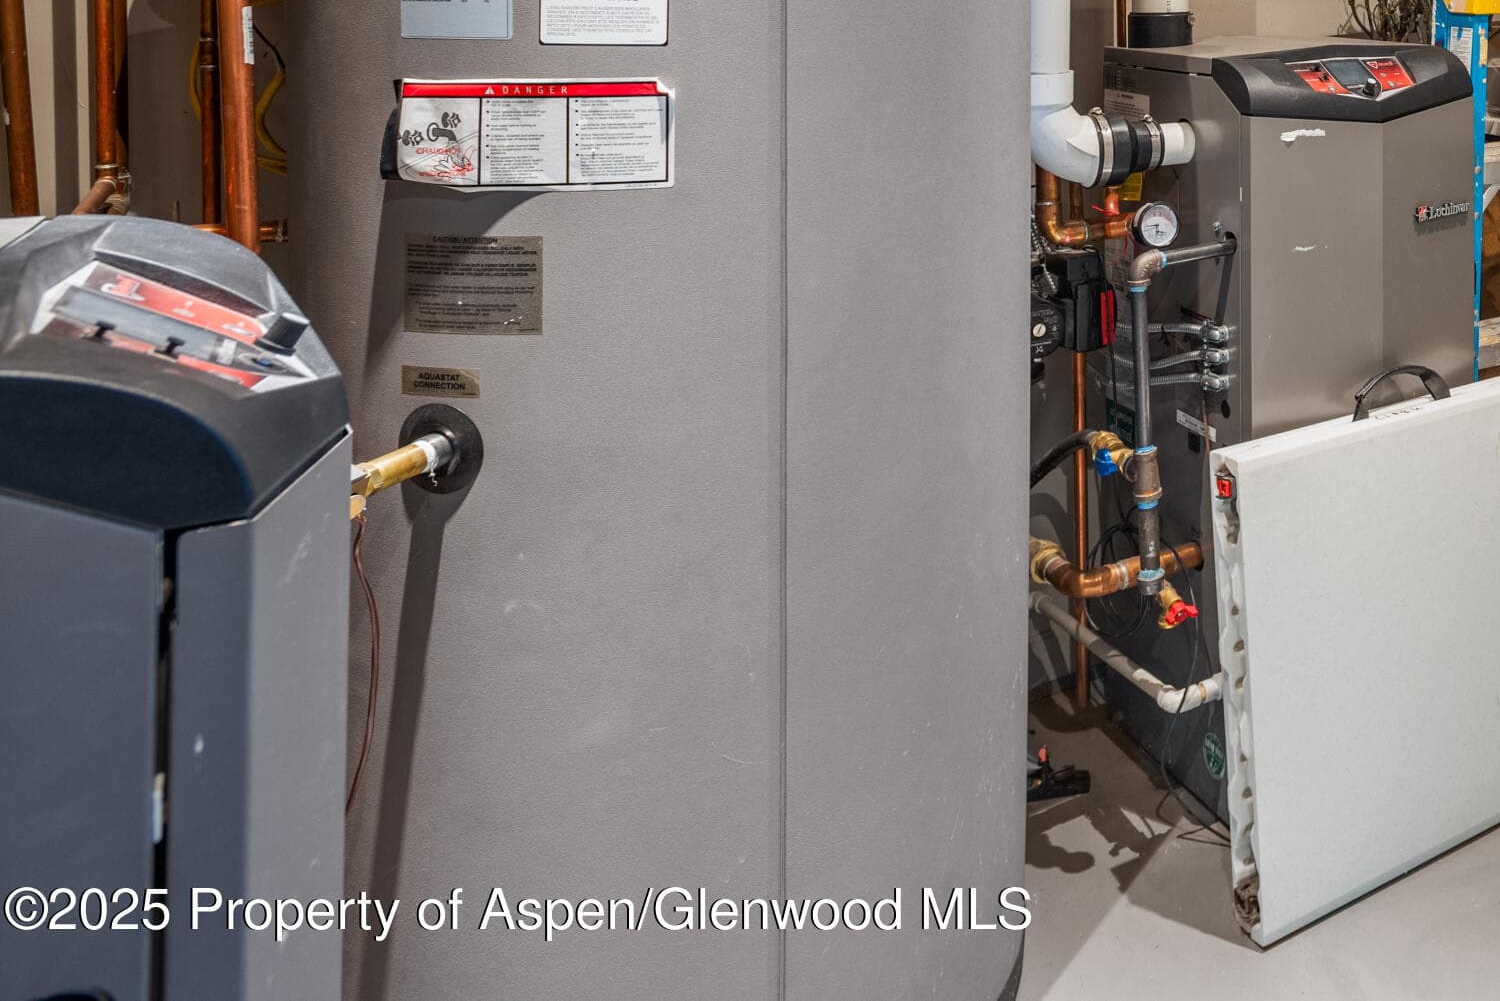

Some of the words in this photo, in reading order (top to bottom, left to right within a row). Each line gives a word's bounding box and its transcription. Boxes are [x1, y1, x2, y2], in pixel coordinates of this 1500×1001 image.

[502, 85, 568, 95] DANGER
[1429, 201, 1469, 220] Lochinvar
[418, 372, 461, 382] AQUASTAT
[412, 380, 466, 391] CONNECTION
